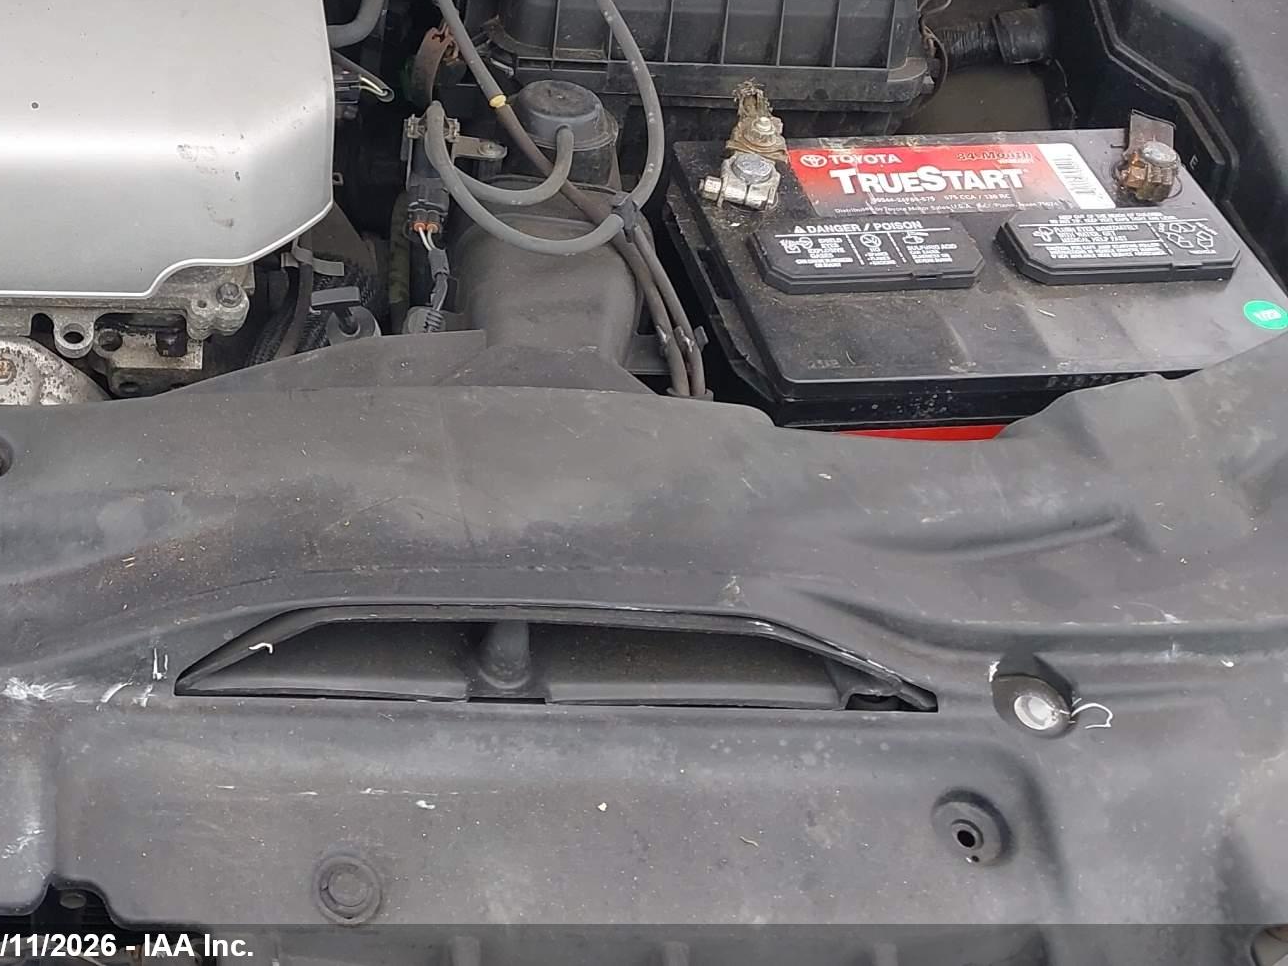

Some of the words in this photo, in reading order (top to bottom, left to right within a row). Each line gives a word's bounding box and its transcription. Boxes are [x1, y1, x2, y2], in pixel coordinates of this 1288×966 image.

[827, 153, 903, 165] TOYOTA
[806, 224, 862, 234] DANGER
[873, 220, 923, 231] POISON
